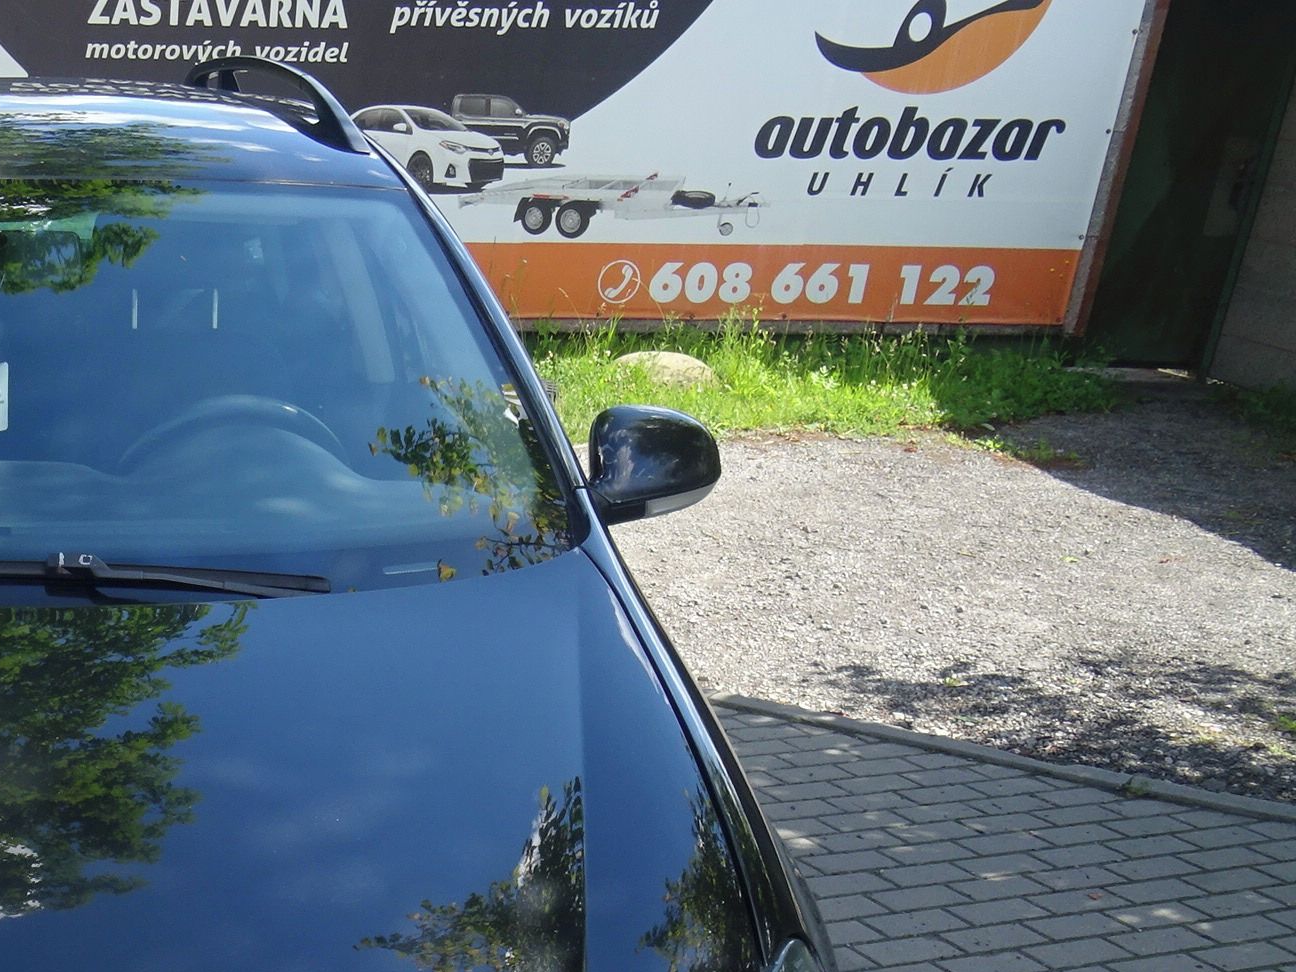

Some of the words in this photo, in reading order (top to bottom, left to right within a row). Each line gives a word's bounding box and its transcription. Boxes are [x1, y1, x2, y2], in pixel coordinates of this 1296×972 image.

[389, 0, 550, 36] přívěsných
[564, 0, 660, 29] vozíků
[85, 40, 241, 65] motorových
[254, 41, 349, 63] vozidel
[754, 106, 1066, 162] autobazar
[649, 261, 753, 304] 608
[770, 262, 869, 304] 661
[899, 264, 996, 306] 122
